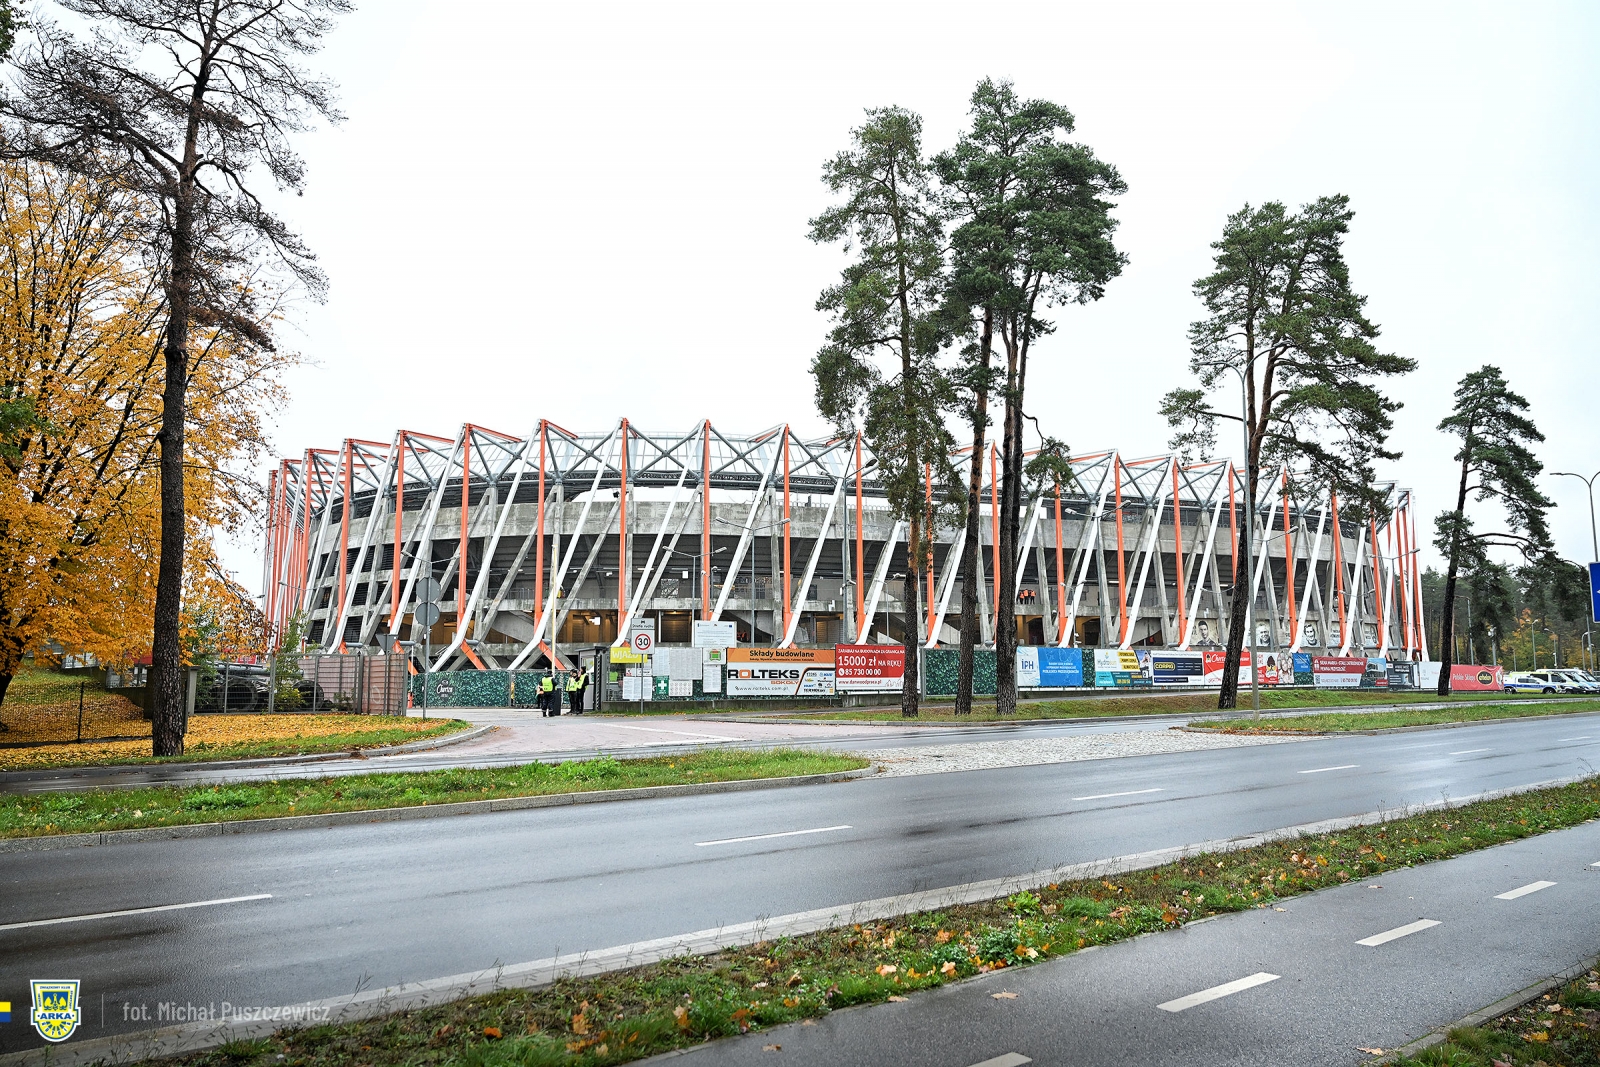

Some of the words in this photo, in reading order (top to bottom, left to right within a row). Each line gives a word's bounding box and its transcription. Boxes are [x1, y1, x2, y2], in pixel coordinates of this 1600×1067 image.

[638, 638, 649, 646] 30
[749, 650, 773, 658] Składy
[775, 650, 815, 658] budowlane
[838, 655, 867, 666] 15000
[868, 656, 877, 666] zł
[728, 669, 799, 679] ROLTEKS
[845, 668, 853, 676] 85
[853, 668, 865, 676] 730
[865, 668, 873, 676] 00
[874, 668, 882, 676] 00
